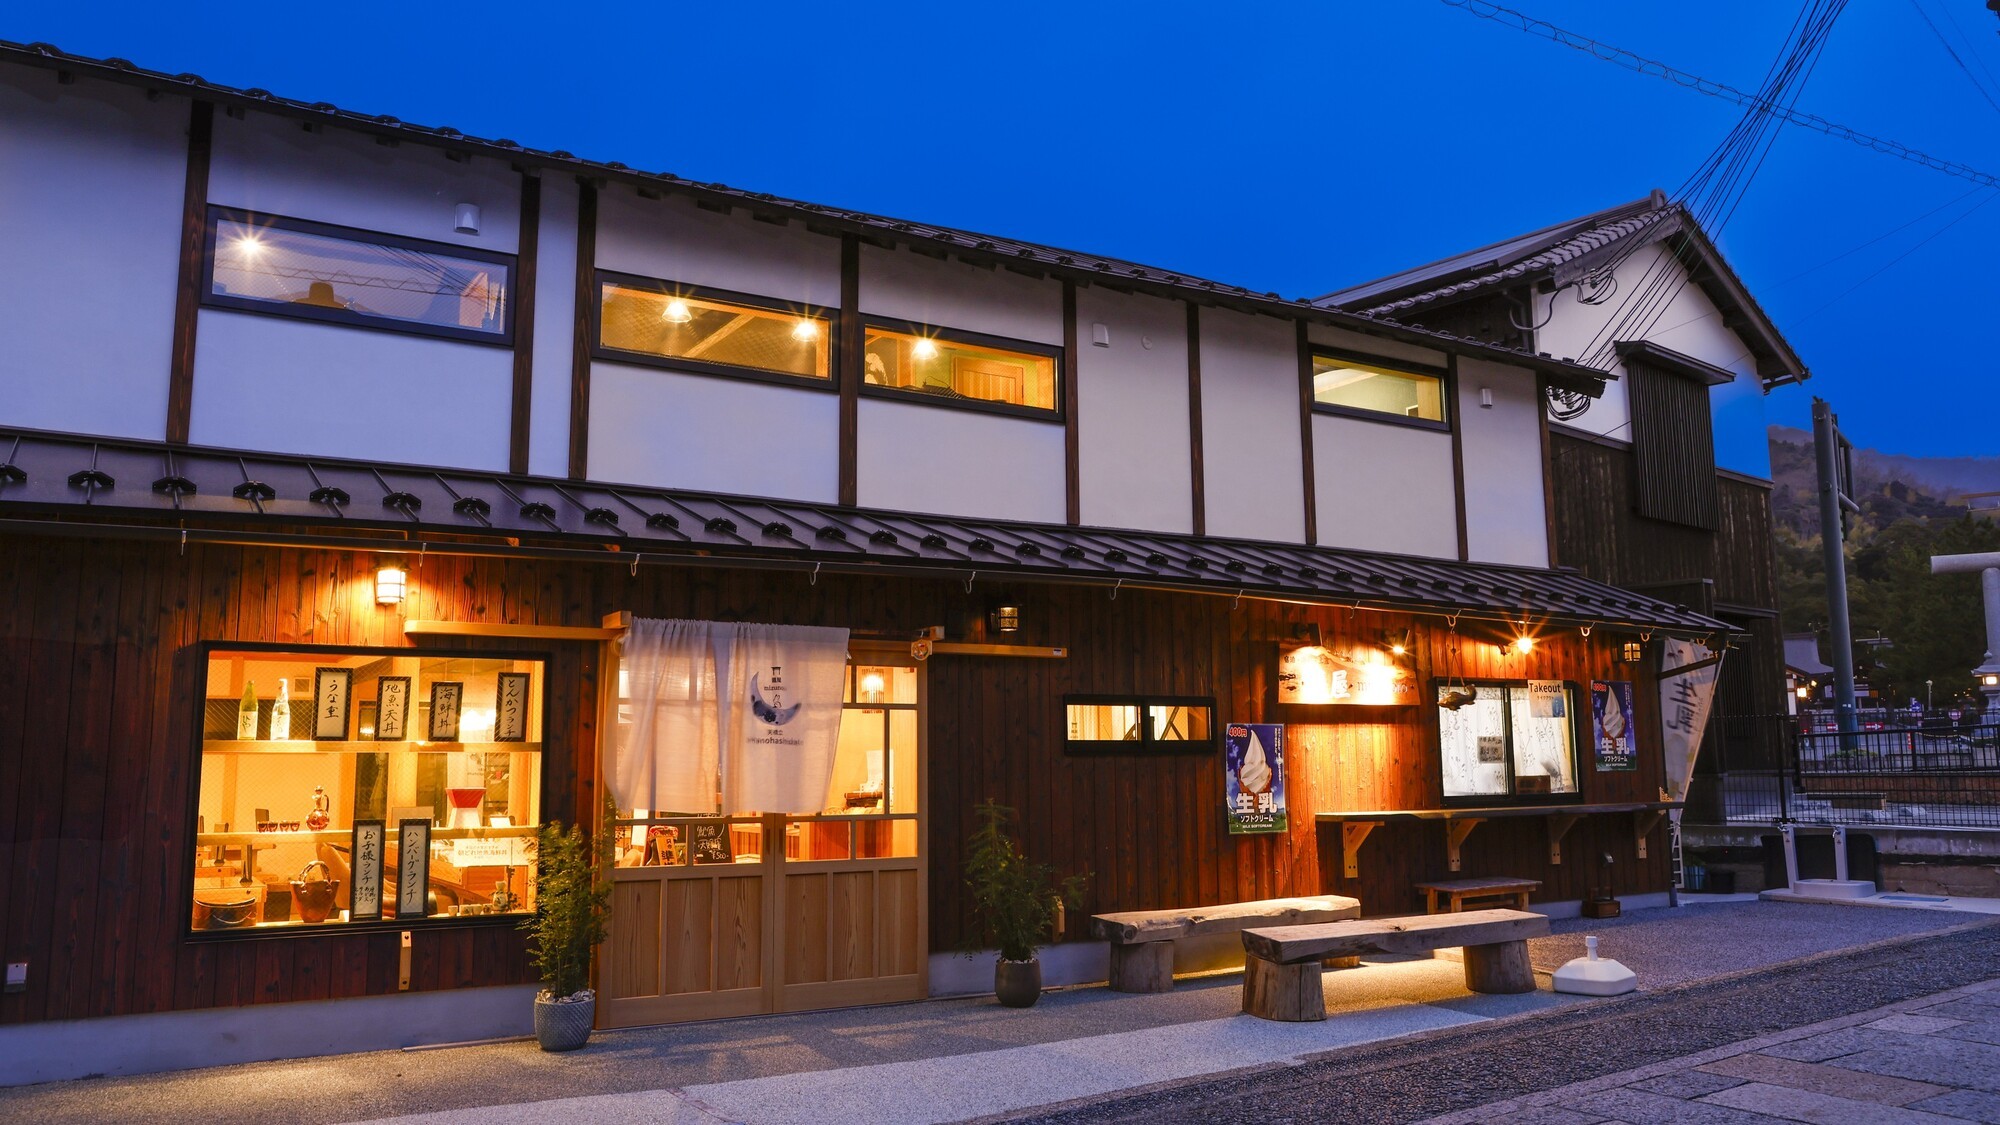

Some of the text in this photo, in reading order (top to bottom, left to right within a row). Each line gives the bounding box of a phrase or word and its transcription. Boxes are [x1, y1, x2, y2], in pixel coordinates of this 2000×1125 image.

[324, 680, 339, 719] うな重
[504, 679, 519, 736] とんかつランチ
[1529, 682, 1561, 694] Takeout
[382, 684, 401, 734] 地魚天丼
[438, 687, 455, 734] 海鮮丼
[1229, 727, 1248, 737] 400円
[1601, 737, 1630, 755] 生乳
[1236, 792, 1278, 814] 生乳
[1240, 815, 1275, 823] ソフトクリーム
[361, 830, 377, 885] お子様ランチ
[406, 832, 420, 905] ハンバーグランチ
